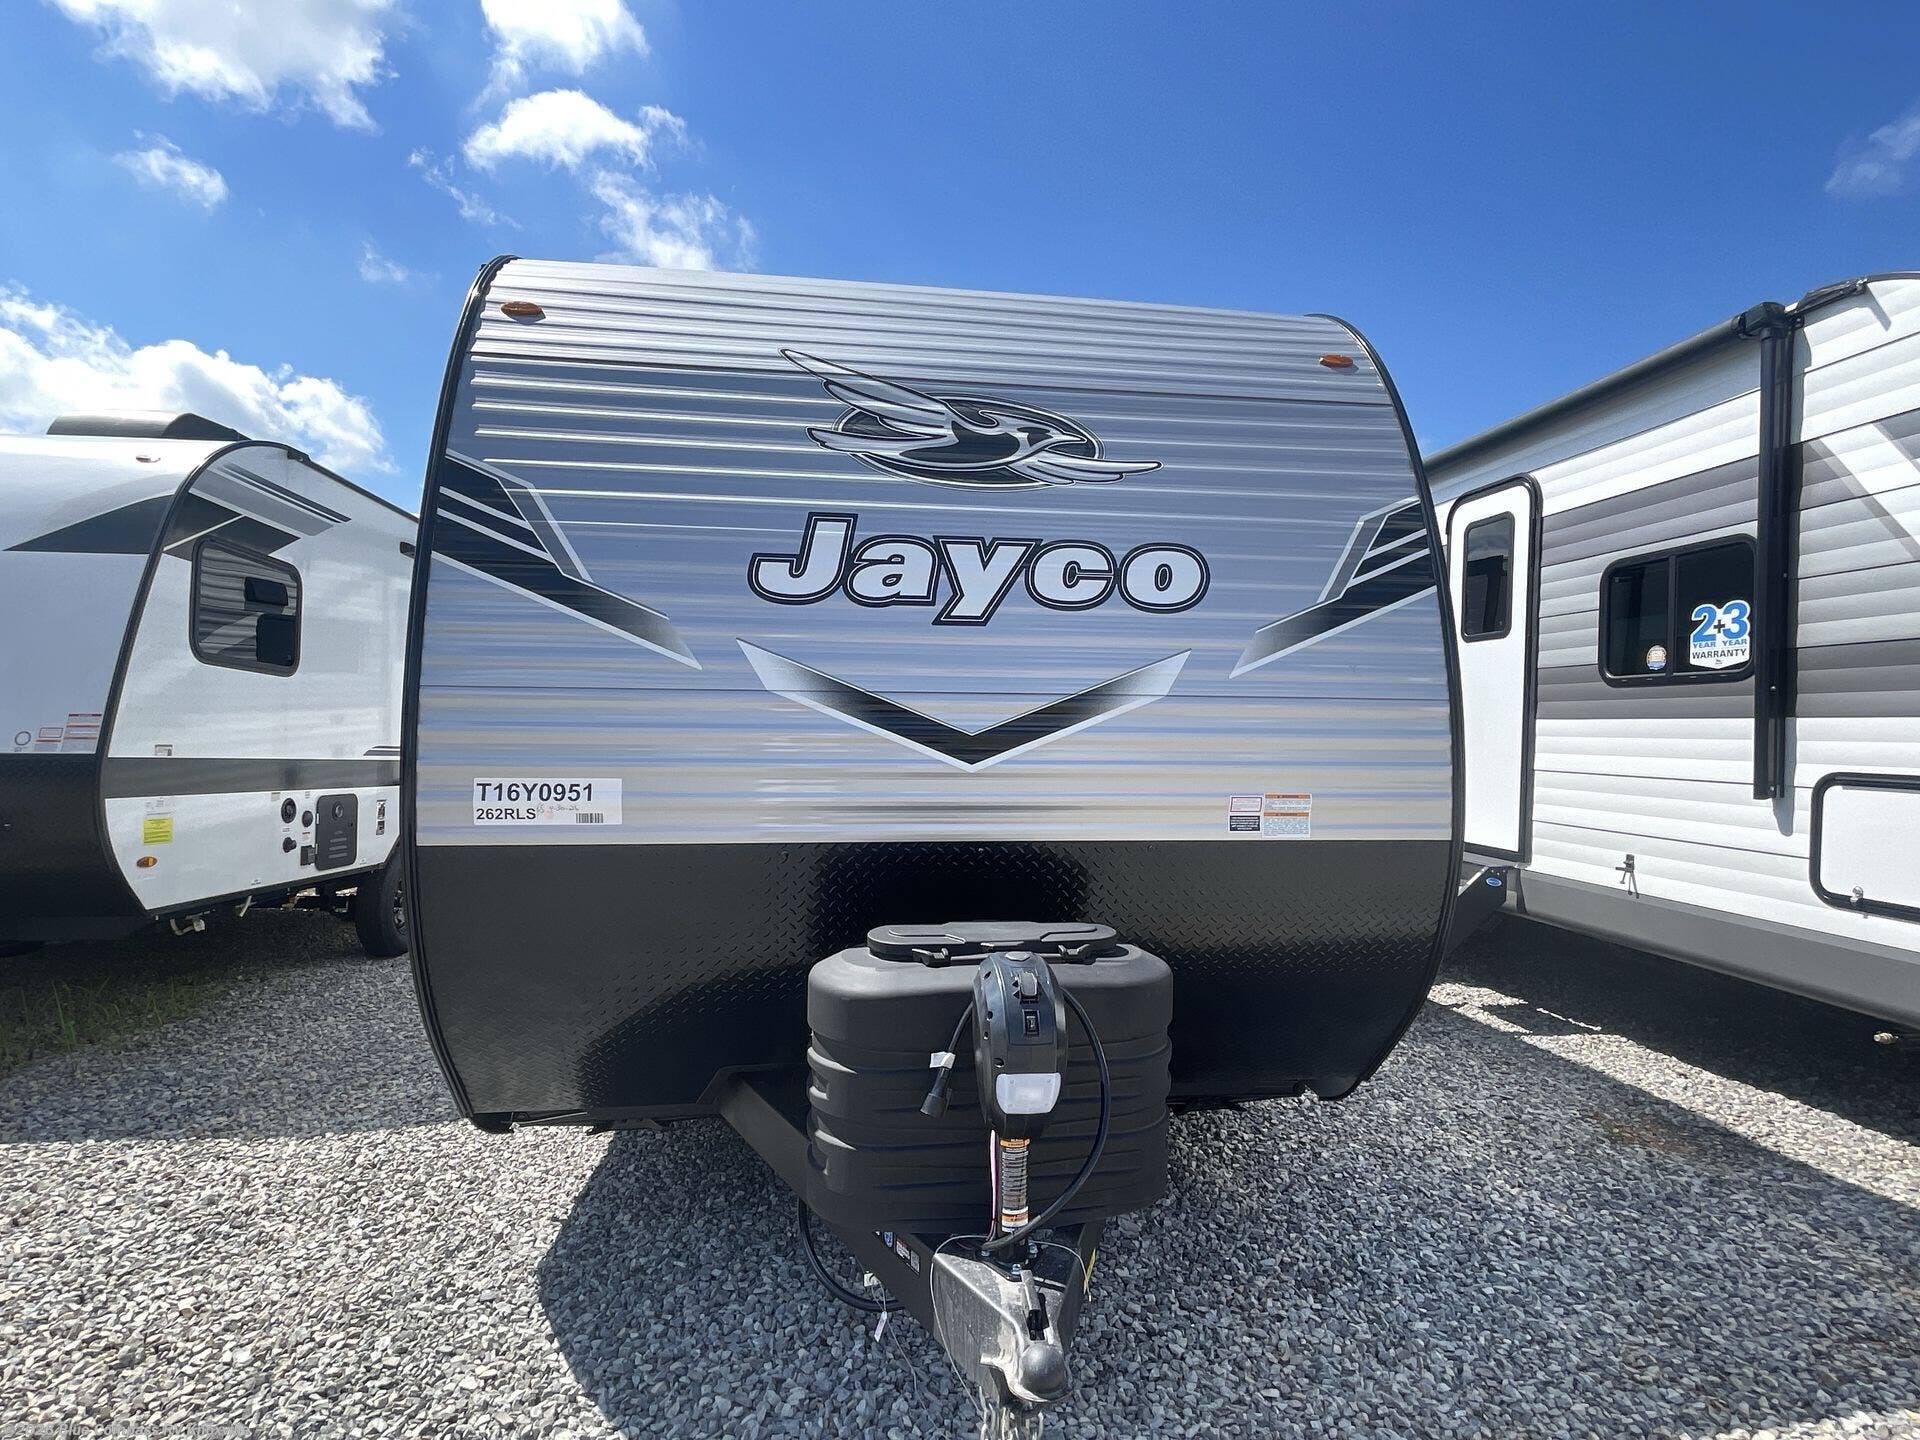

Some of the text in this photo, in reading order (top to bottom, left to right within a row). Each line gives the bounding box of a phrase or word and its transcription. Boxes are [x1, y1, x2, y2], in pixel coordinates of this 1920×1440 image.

[747, 511, 1210, 626] Jayco
[1693, 641, 1716, 649] YEAR
[1692, 648, 1747, 659] WARRANTY
[476, 783, 592, 802] T16Y0951
[476, 808, 537, 820] 262RLS
